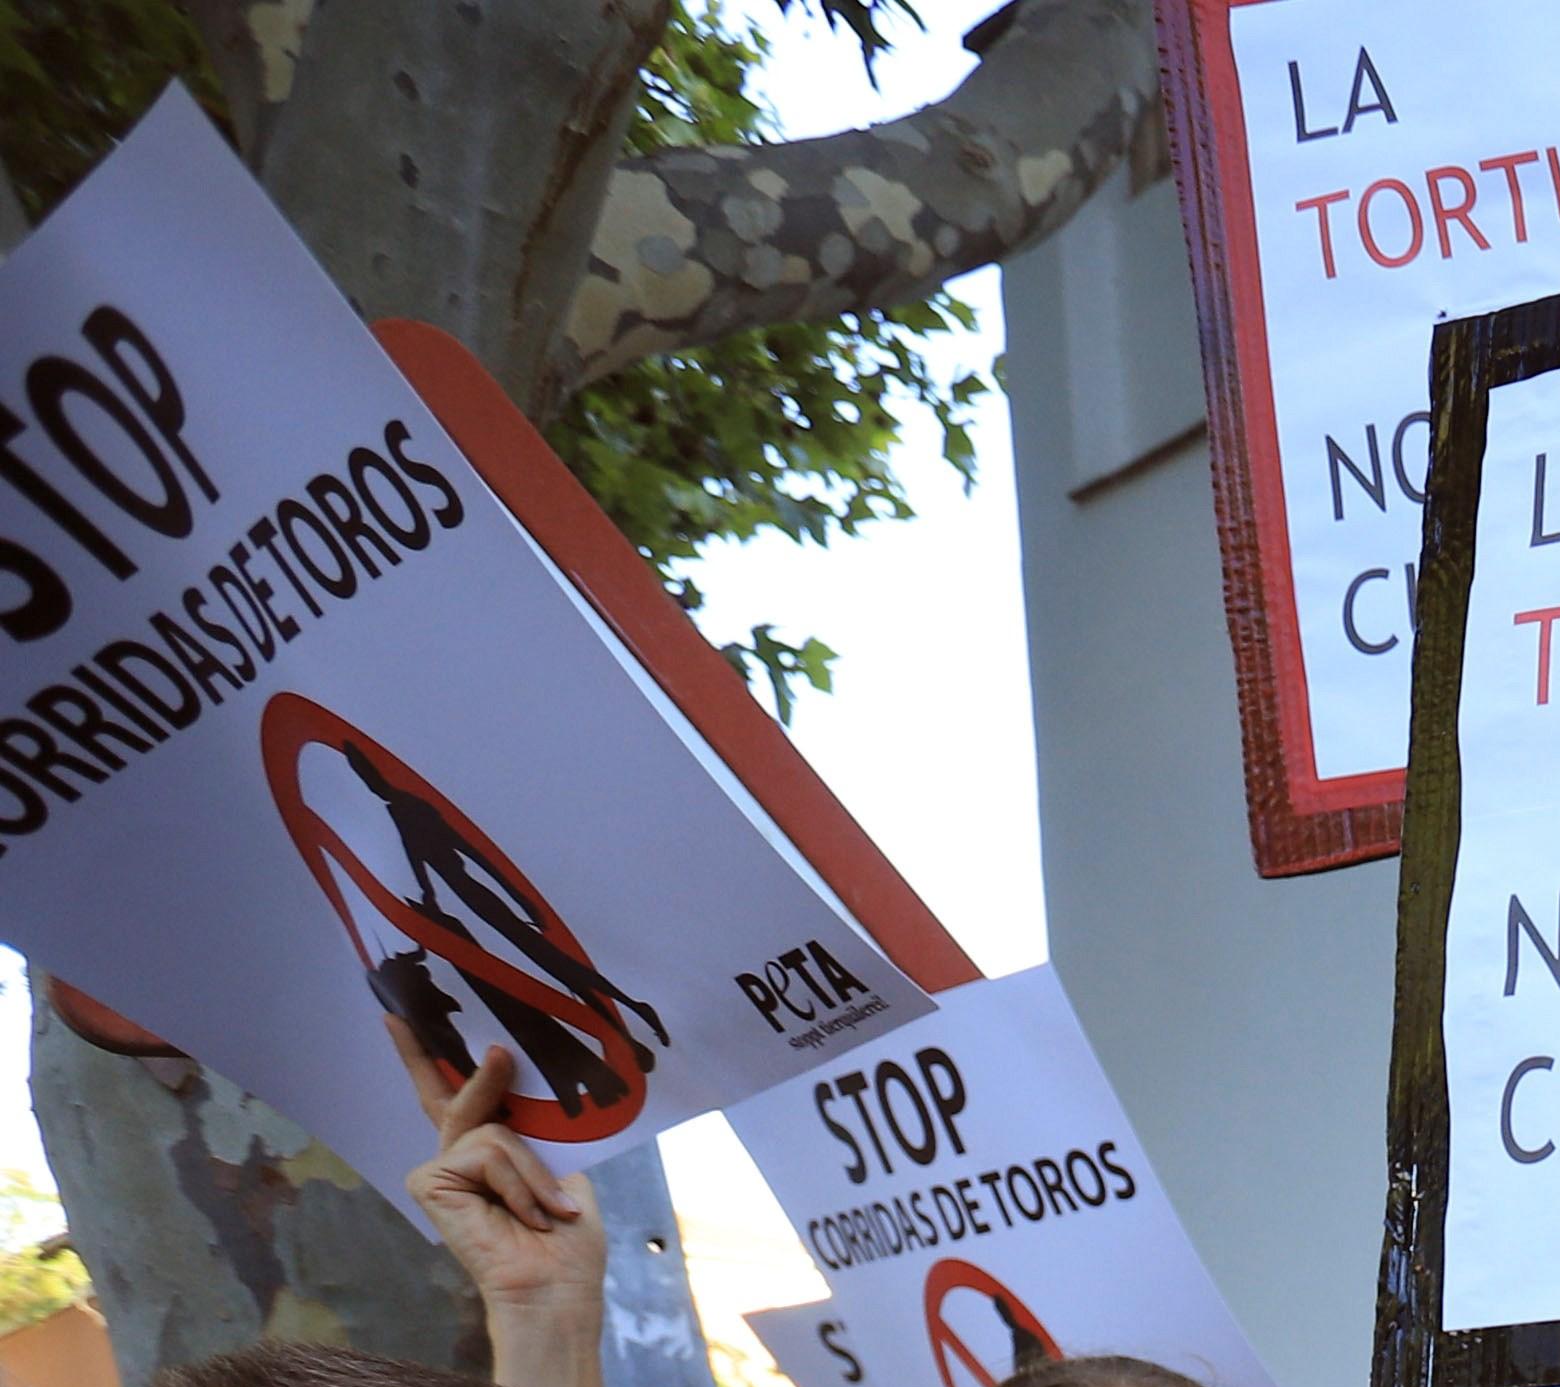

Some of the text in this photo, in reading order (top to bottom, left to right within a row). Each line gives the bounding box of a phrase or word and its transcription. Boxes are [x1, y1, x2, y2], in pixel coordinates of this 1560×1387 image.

[1288, 45, 1399, 144] LA
[0, 418, 465, 860] ORRIDAS DE TOROS
[813, 1046, 966, 1186] STOP
[807, 1140, 1138, 1272] CORRIDAS DE TOROS
